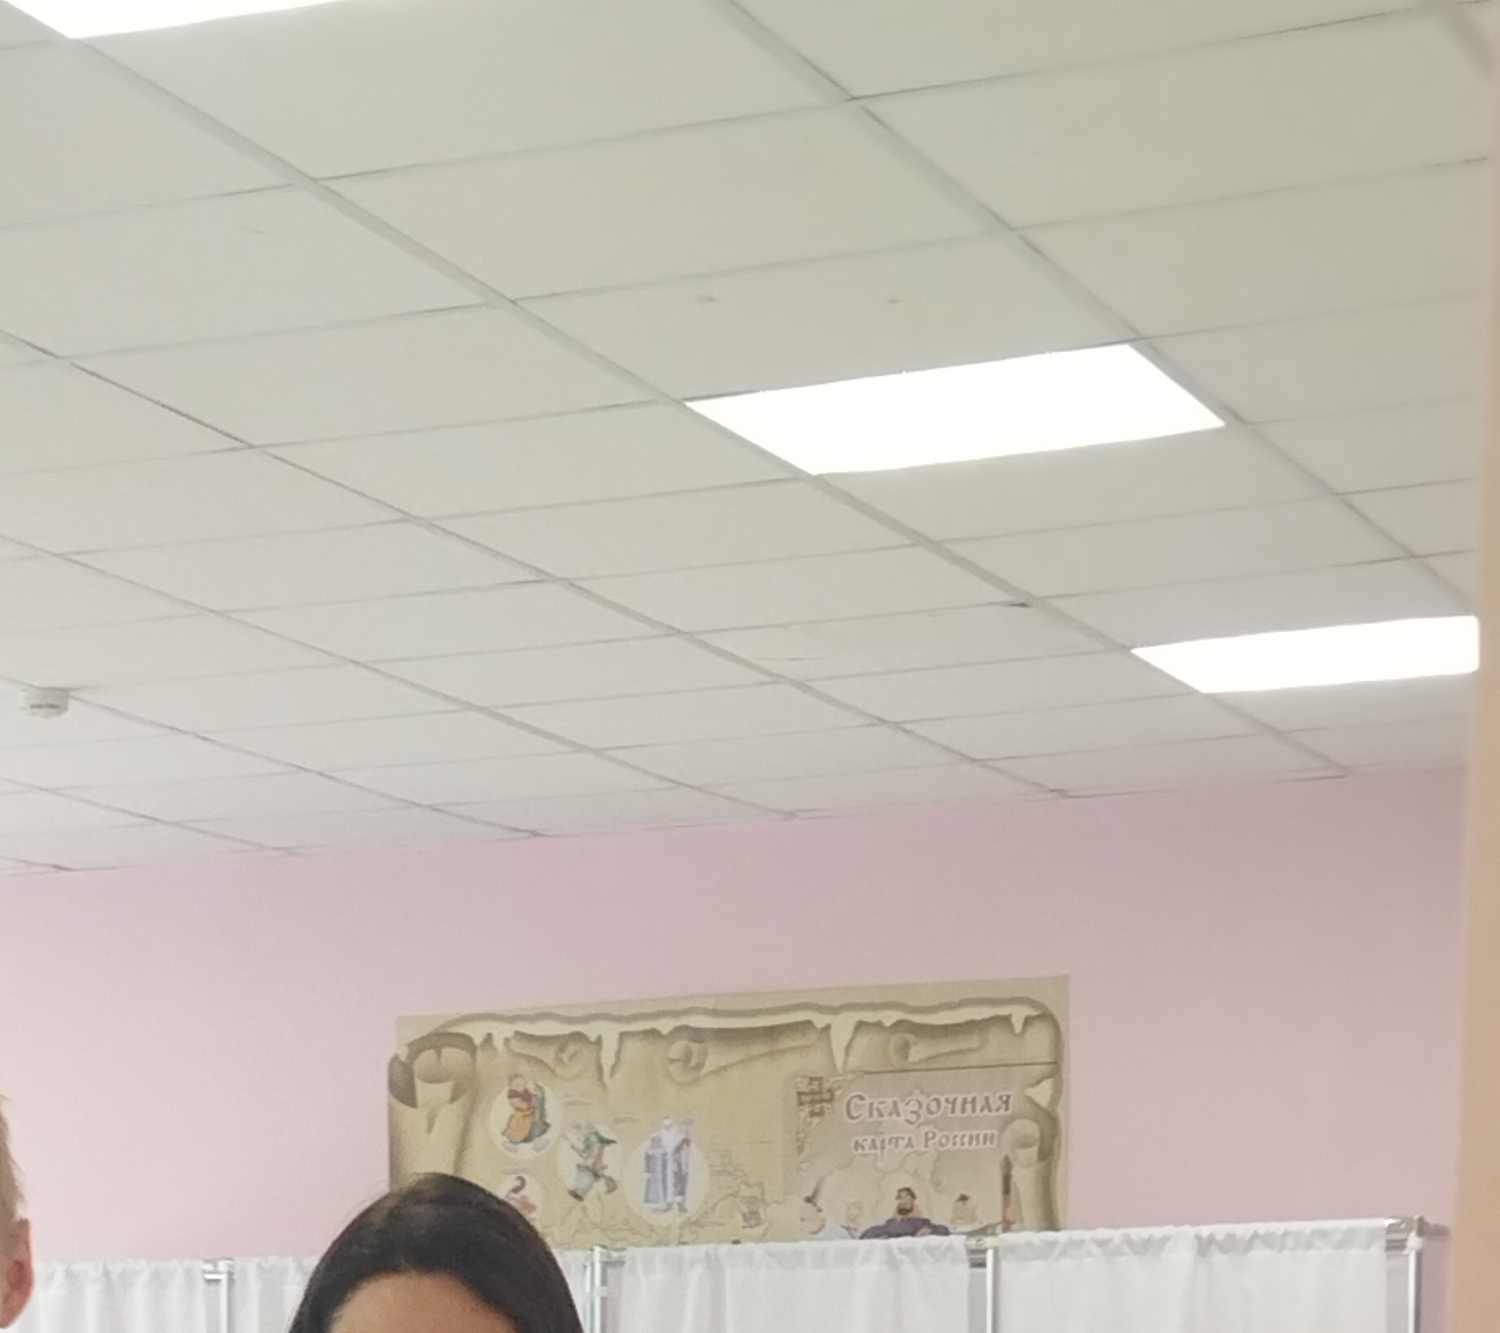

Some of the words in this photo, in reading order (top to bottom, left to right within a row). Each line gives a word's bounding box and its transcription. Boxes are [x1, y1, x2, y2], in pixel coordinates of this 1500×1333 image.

[844, 1093, 1013, 1126] Сказочная
[853, 1136, 915, 1162] карта
[923, 1129, 997, 1149] России
